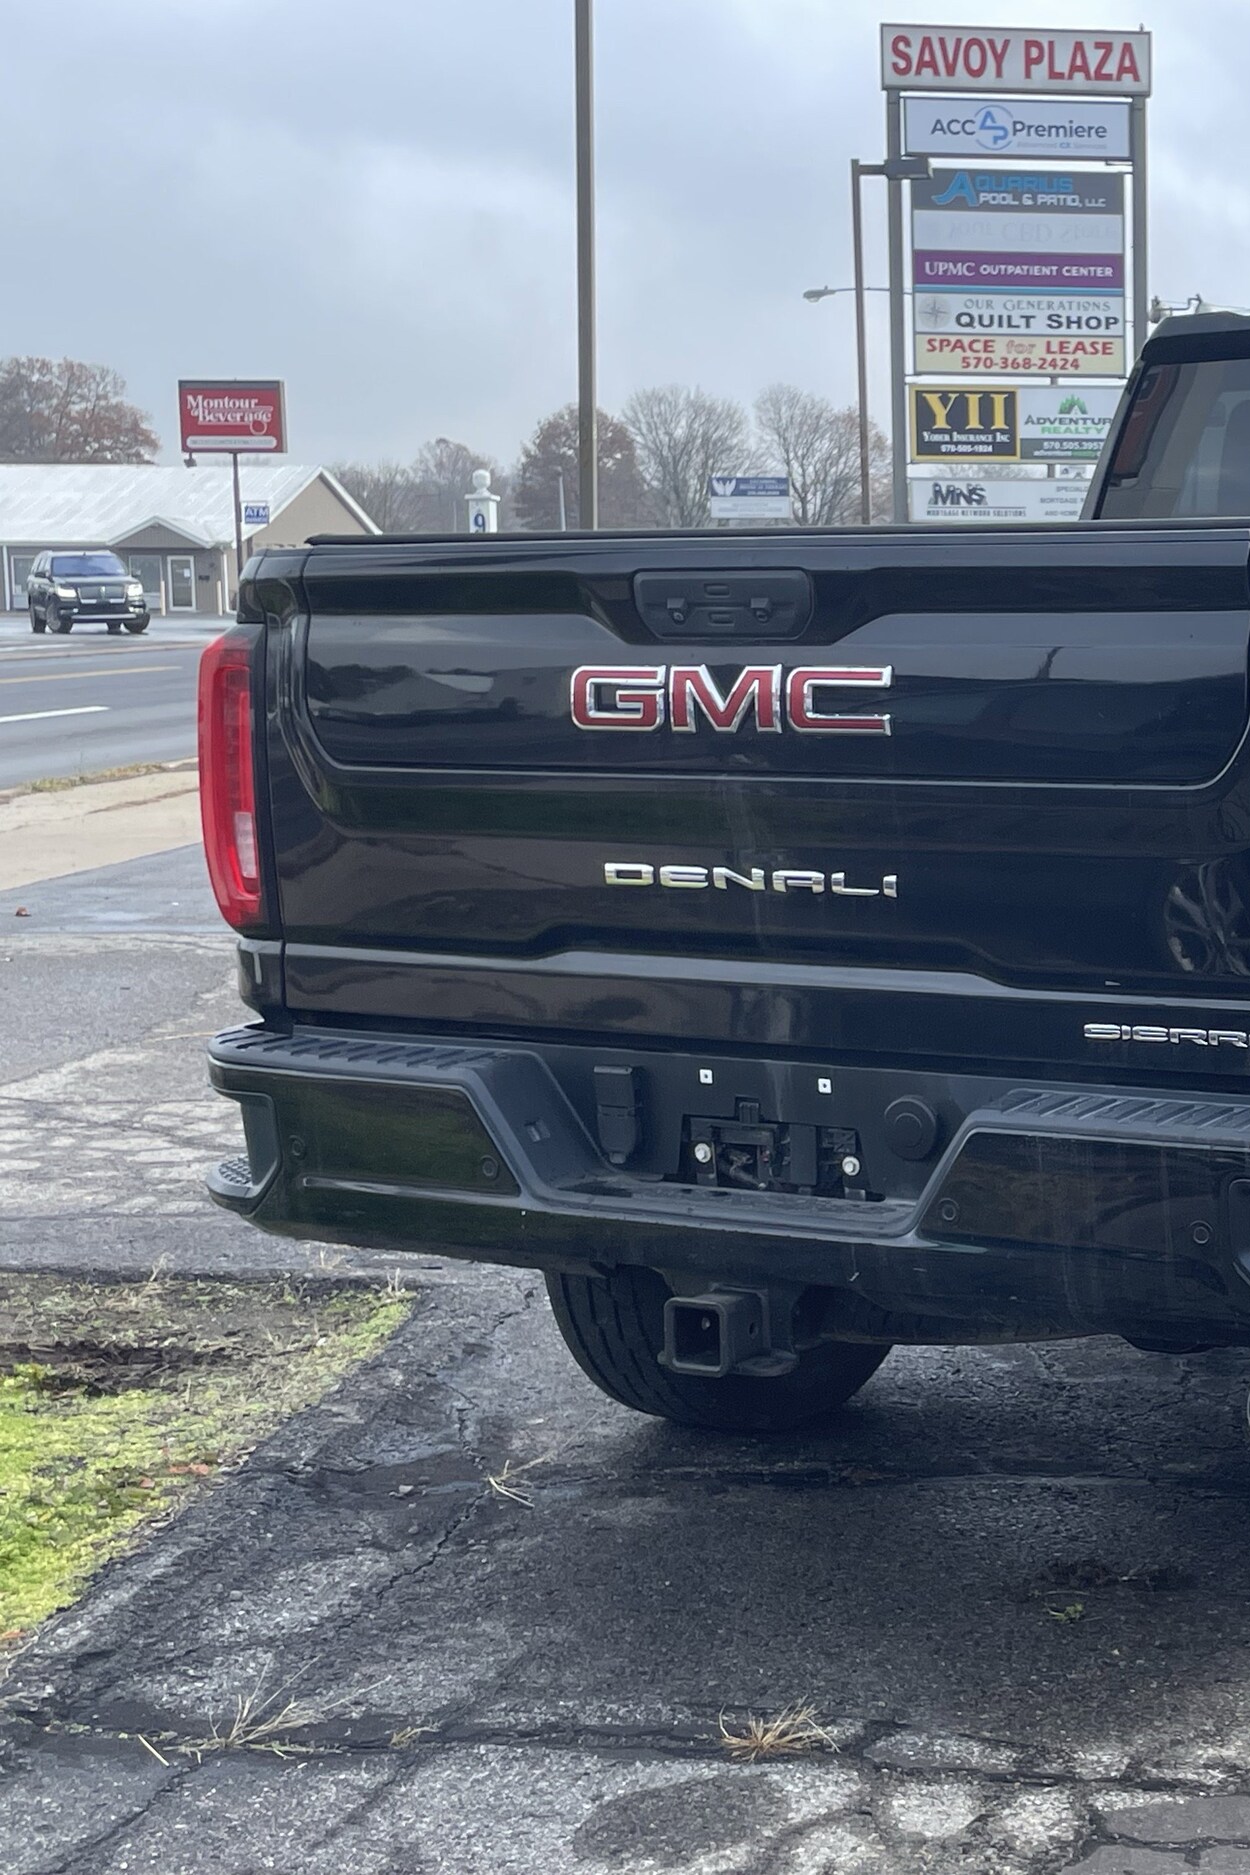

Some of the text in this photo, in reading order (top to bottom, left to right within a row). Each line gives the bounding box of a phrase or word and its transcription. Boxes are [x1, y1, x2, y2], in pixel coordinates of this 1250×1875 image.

[891, 34, 1141, 83] SAVOY PLAZA
[930, 118, 976, 136] ACC
[1012, 119, 1108, 138] Premiere
[931, 171, 1073, 207] AQUARIUS
[979, 192, 1019, 206] POOL
[1021, 194, 1036, 206] &
[1085, 198, 1107, 208] LLC
[925, 261, 1114, 277] UPMC OUTPATIENT CENTER
[963, 298, 1111, 311] OUR GENERATIONS
[955, 312, 1120, 330] QUILT SHOP
[926, 338, 1114, 355] SPACE for LEASE
[961, 356, 1080, 370] 570-368-2424
[186, 394, 259, 410] Montour
[922, 393, 1010, 430] YII
[1024, 414, 1114, 426] ADVENTUR
[191, 408, 273, 435] Beverage
[1041, 426, 1105, 435] REALTY
[245, 507, 269, 517] ATM
[570, 664, 893, 736] GMC
[604, 862, 898, 898] DENALI
